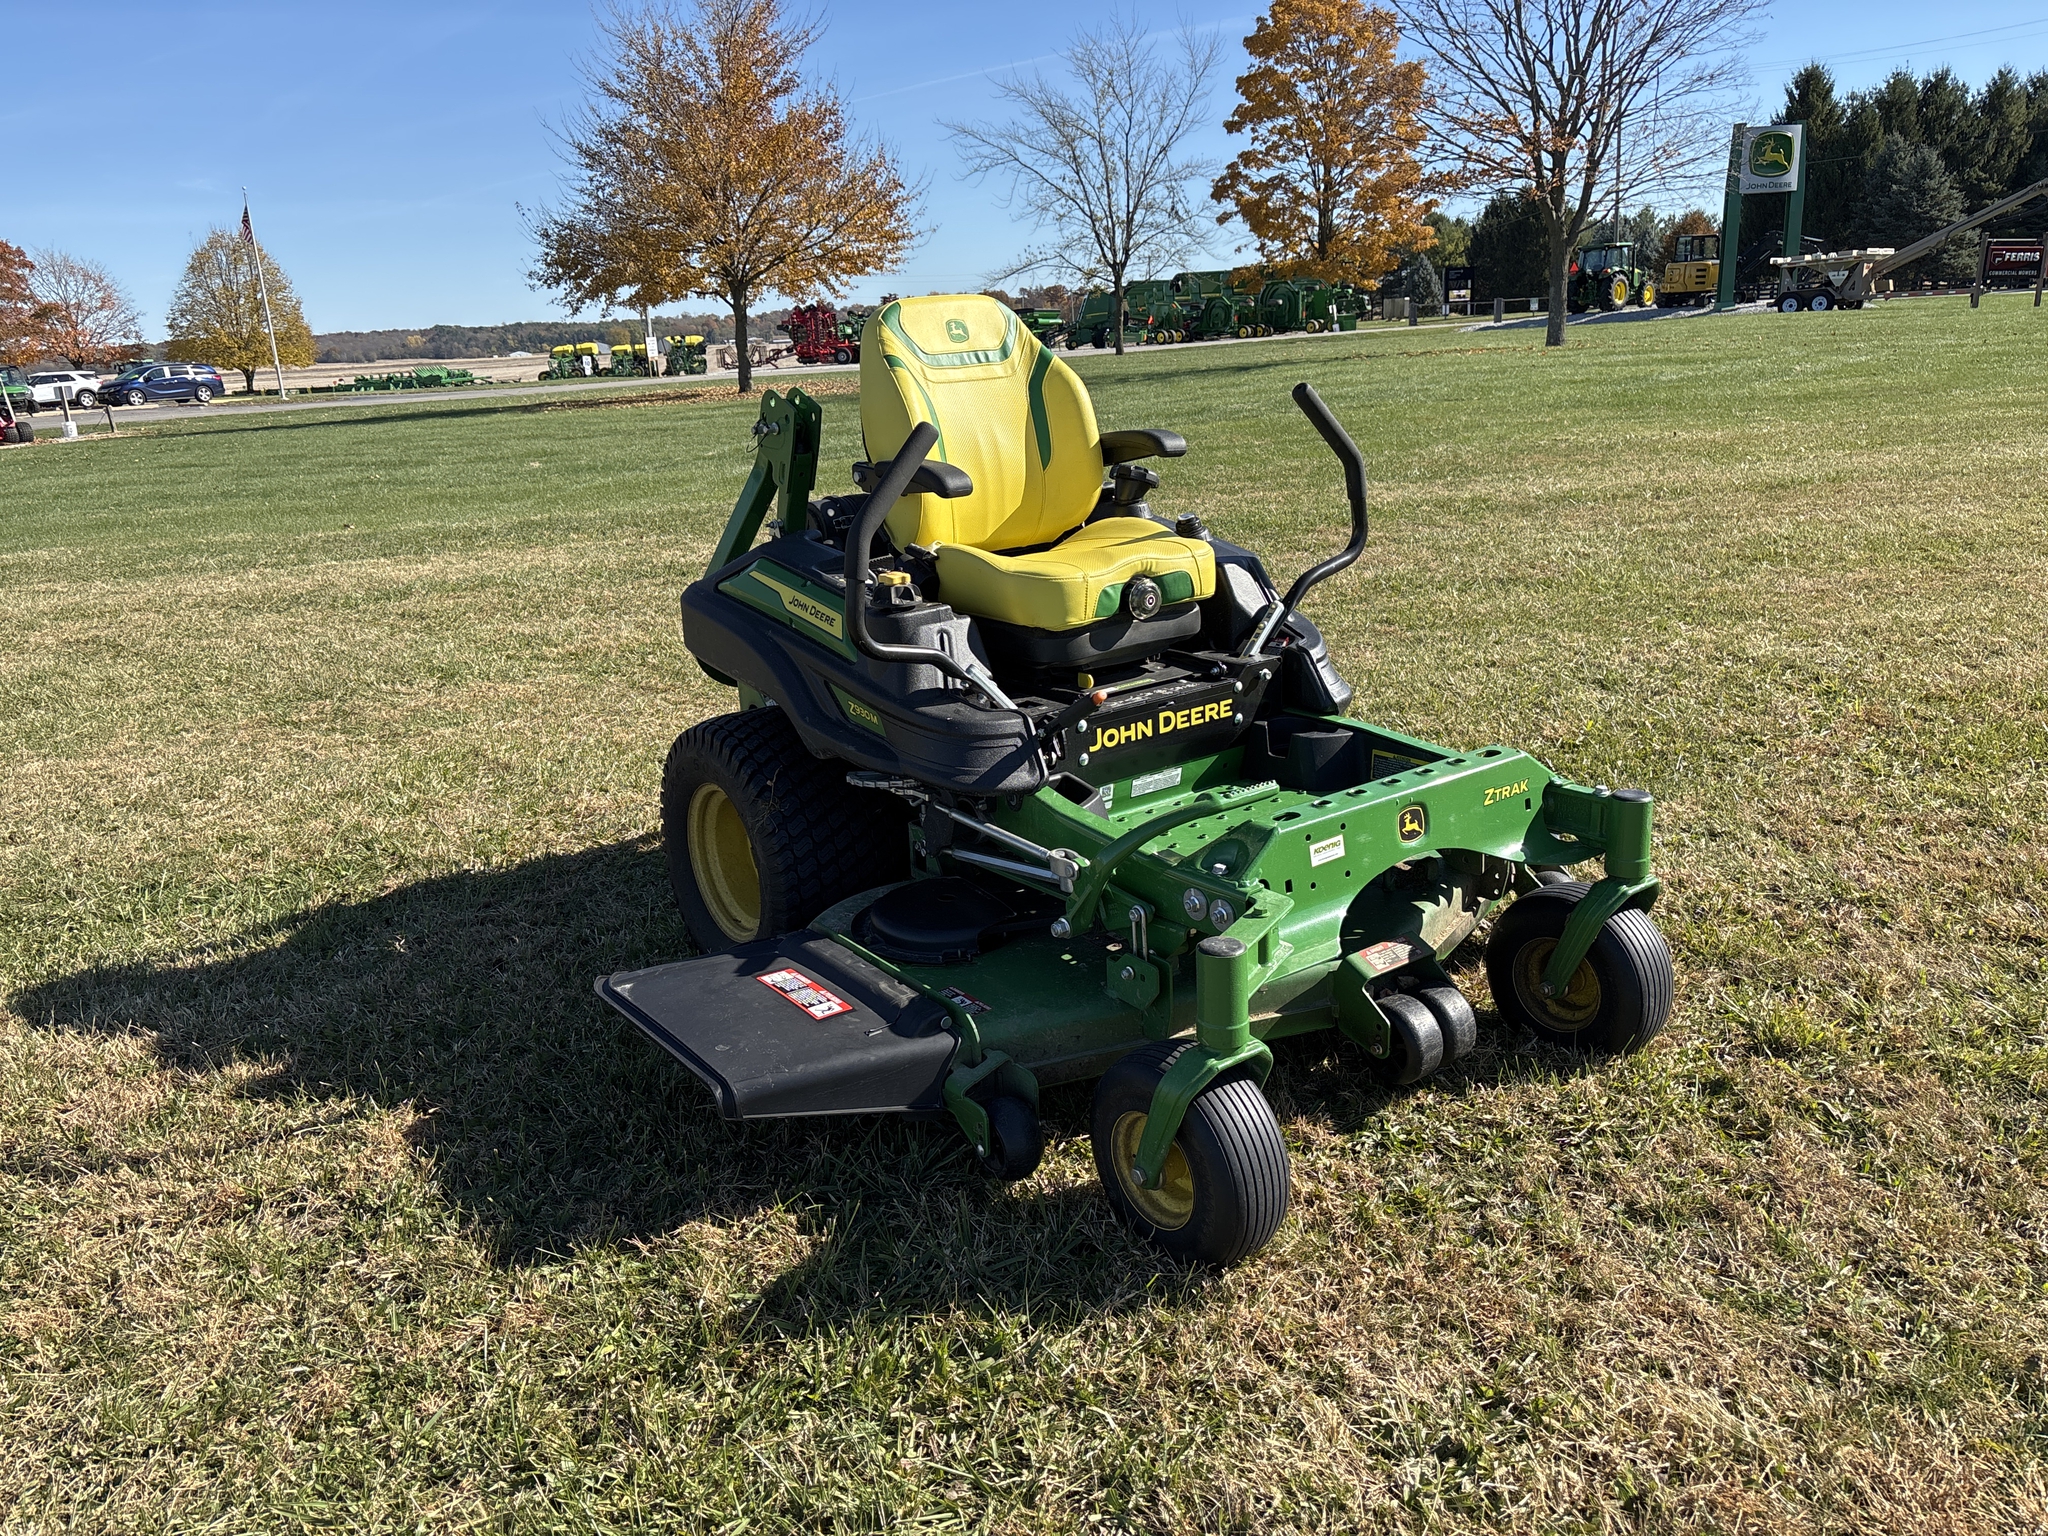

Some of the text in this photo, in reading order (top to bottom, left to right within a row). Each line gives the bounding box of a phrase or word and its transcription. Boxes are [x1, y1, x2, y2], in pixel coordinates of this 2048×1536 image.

[1768, 181, 1793, 189] DEERE
[2004, 252, 2040, 262] FERRIS
[788, 595, 836, 627] JOHN DEERE
[847, 700, 879, 725] Z930M
[1089, 698, 1233, 753] JOHN DEERE
[1483, 777, 1530, 806] ZTRAK
